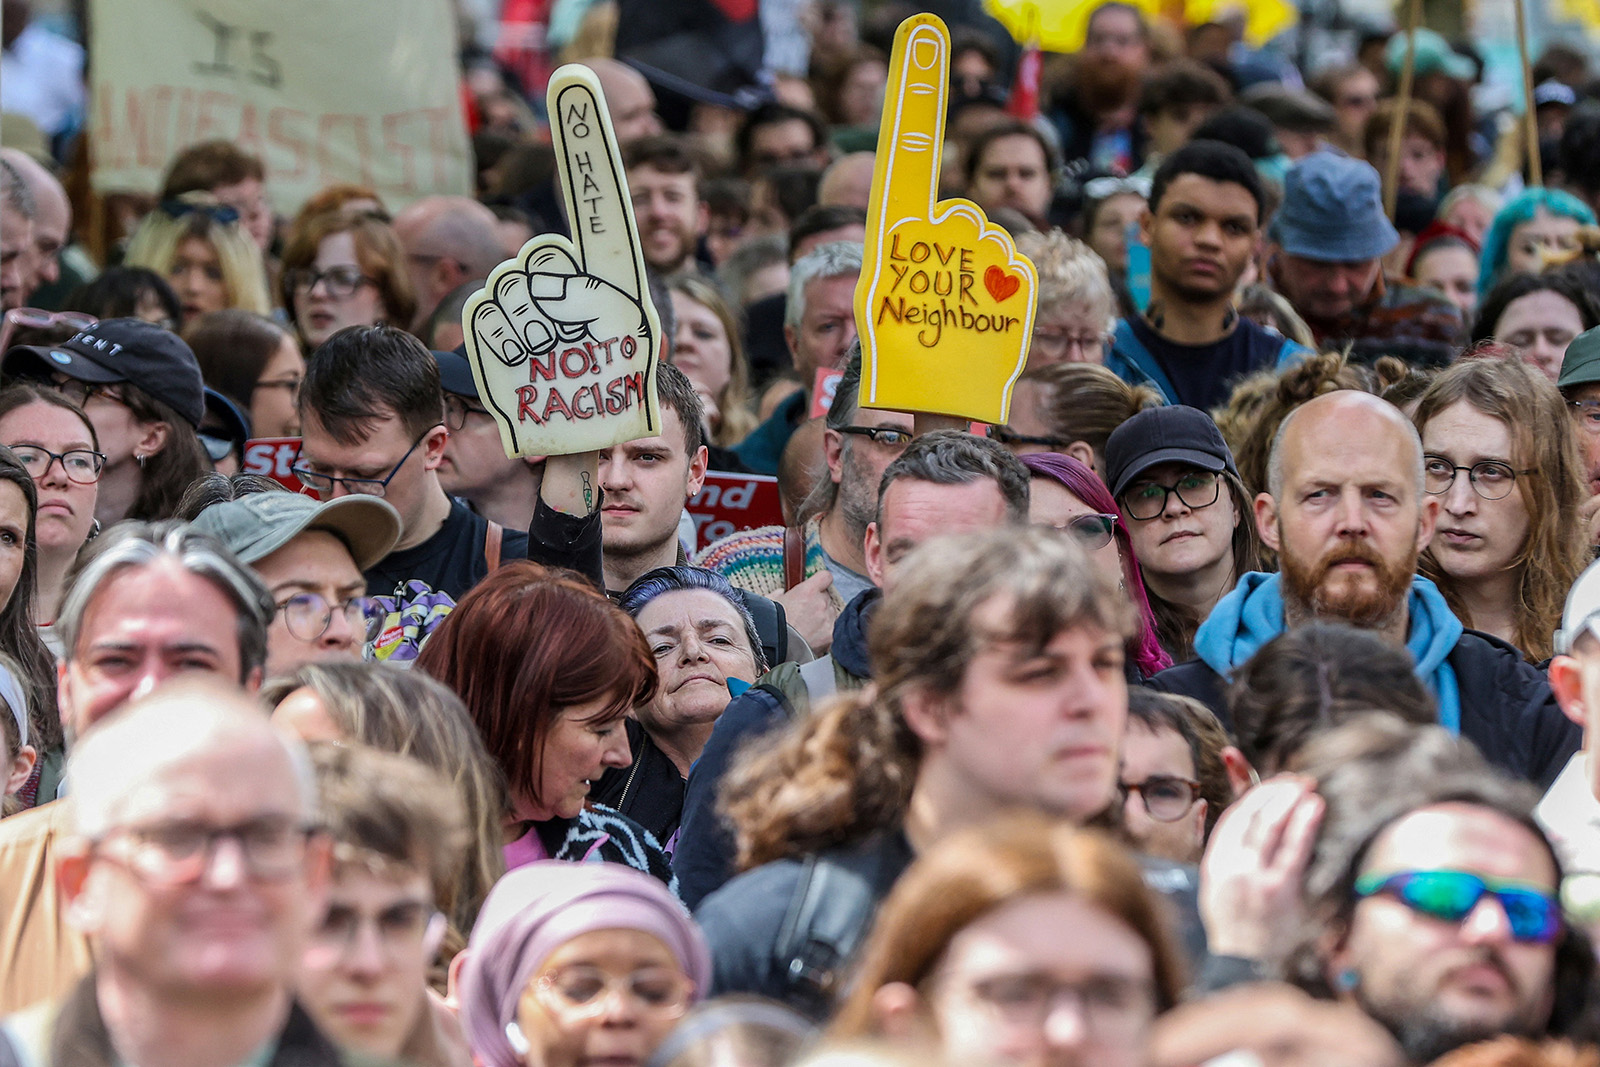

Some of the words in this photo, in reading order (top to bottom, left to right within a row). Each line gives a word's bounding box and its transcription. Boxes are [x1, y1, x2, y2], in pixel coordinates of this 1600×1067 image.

[193, 9, 283, 91] IS
[567, 102, 590, 139] NO
[575, 151, 606, 234] HATE
[890, 233, 975, 273] LOVE
[890, 264, 978, 306] YOUR
[878, 296, 1019, 348] Neighbour
[529, 342, 600, 382] NO!
[594, 334, 637, 365] TO
[515, 371, 644, 424] RACISM
